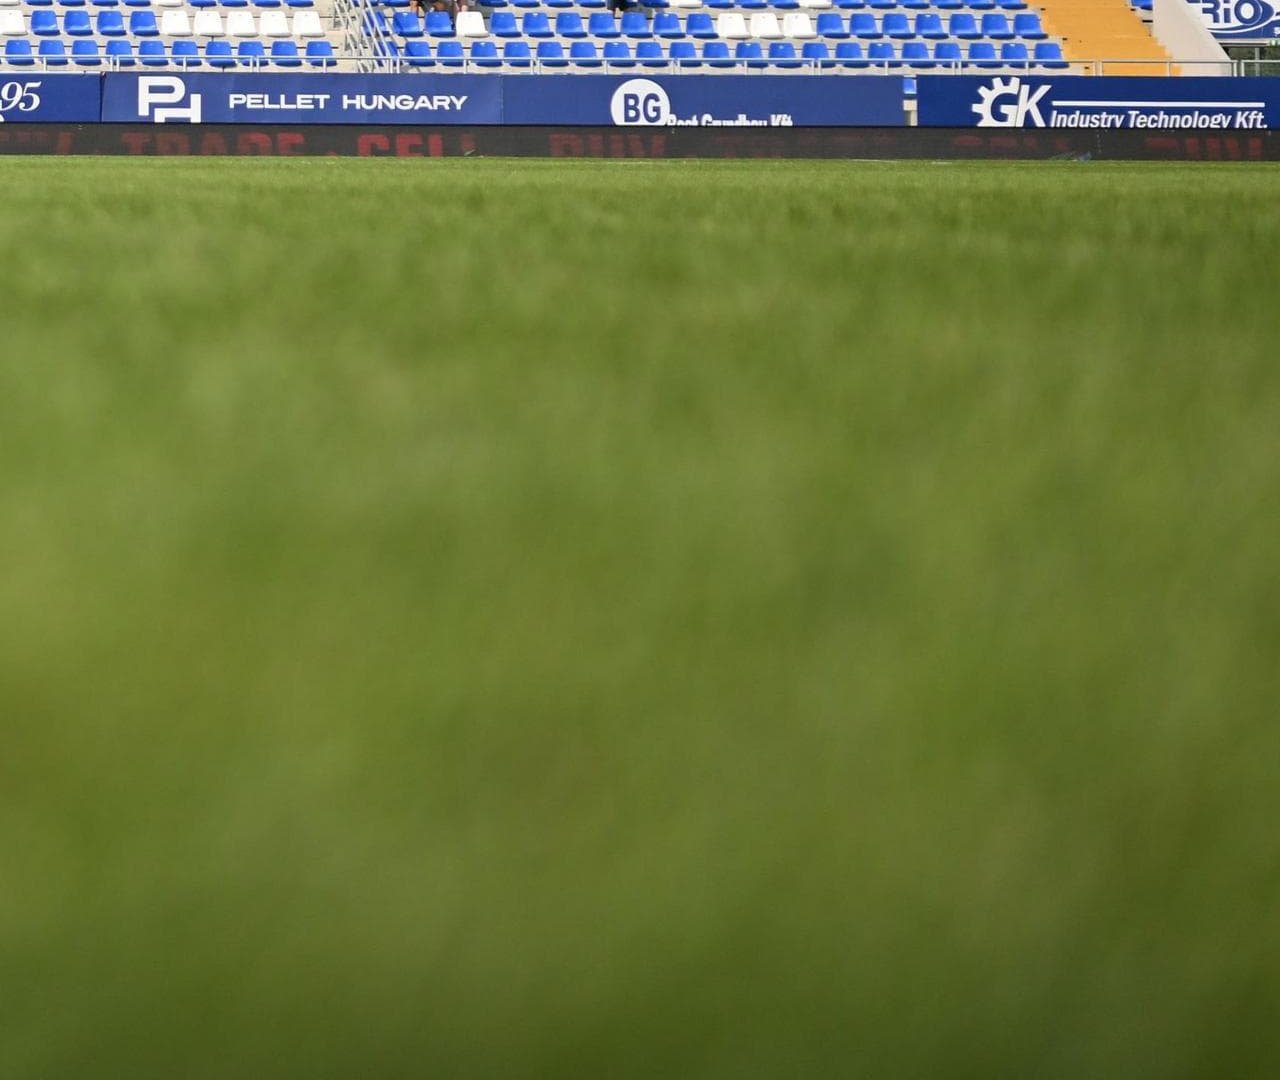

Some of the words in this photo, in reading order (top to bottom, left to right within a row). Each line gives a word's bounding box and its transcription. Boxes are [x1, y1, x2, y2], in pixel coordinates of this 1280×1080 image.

[230, 94, 330, 109] PELLET
[343, 94, 468, 110] HUNGARY
[623, 94, 662, 122] BG
[1050, 111, 1124, 128] Industry
[1129, 111, 1231, 128] Technology
[1235, 111, 1268, 128] Kft.
